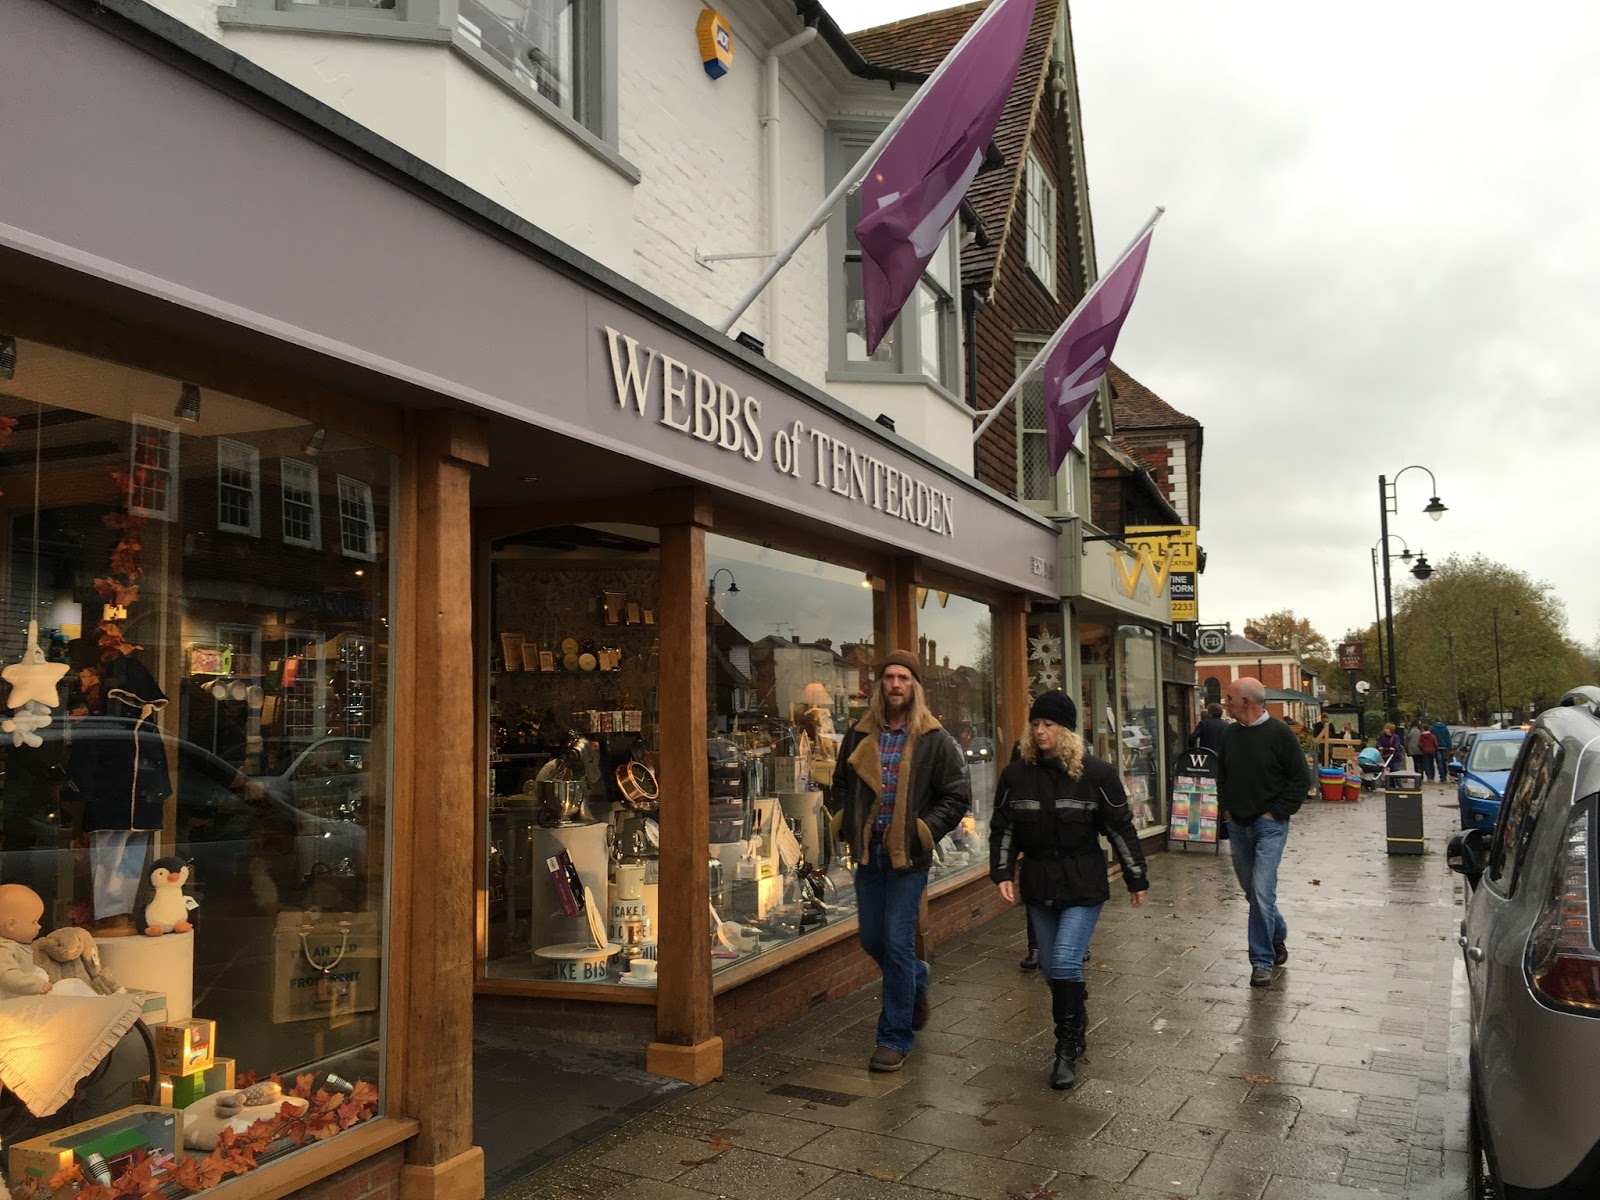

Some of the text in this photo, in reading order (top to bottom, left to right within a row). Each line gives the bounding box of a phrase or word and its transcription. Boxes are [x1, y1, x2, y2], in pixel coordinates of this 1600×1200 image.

[605, 325, 955, 538] WEBBS of TENTERDEN
[1106, 549, 1178, 598] W
[1171, 602, 1193, 611] 2233
[1189, 754, 1208, 767] W
[614, 904, 640, 918] CAKE
